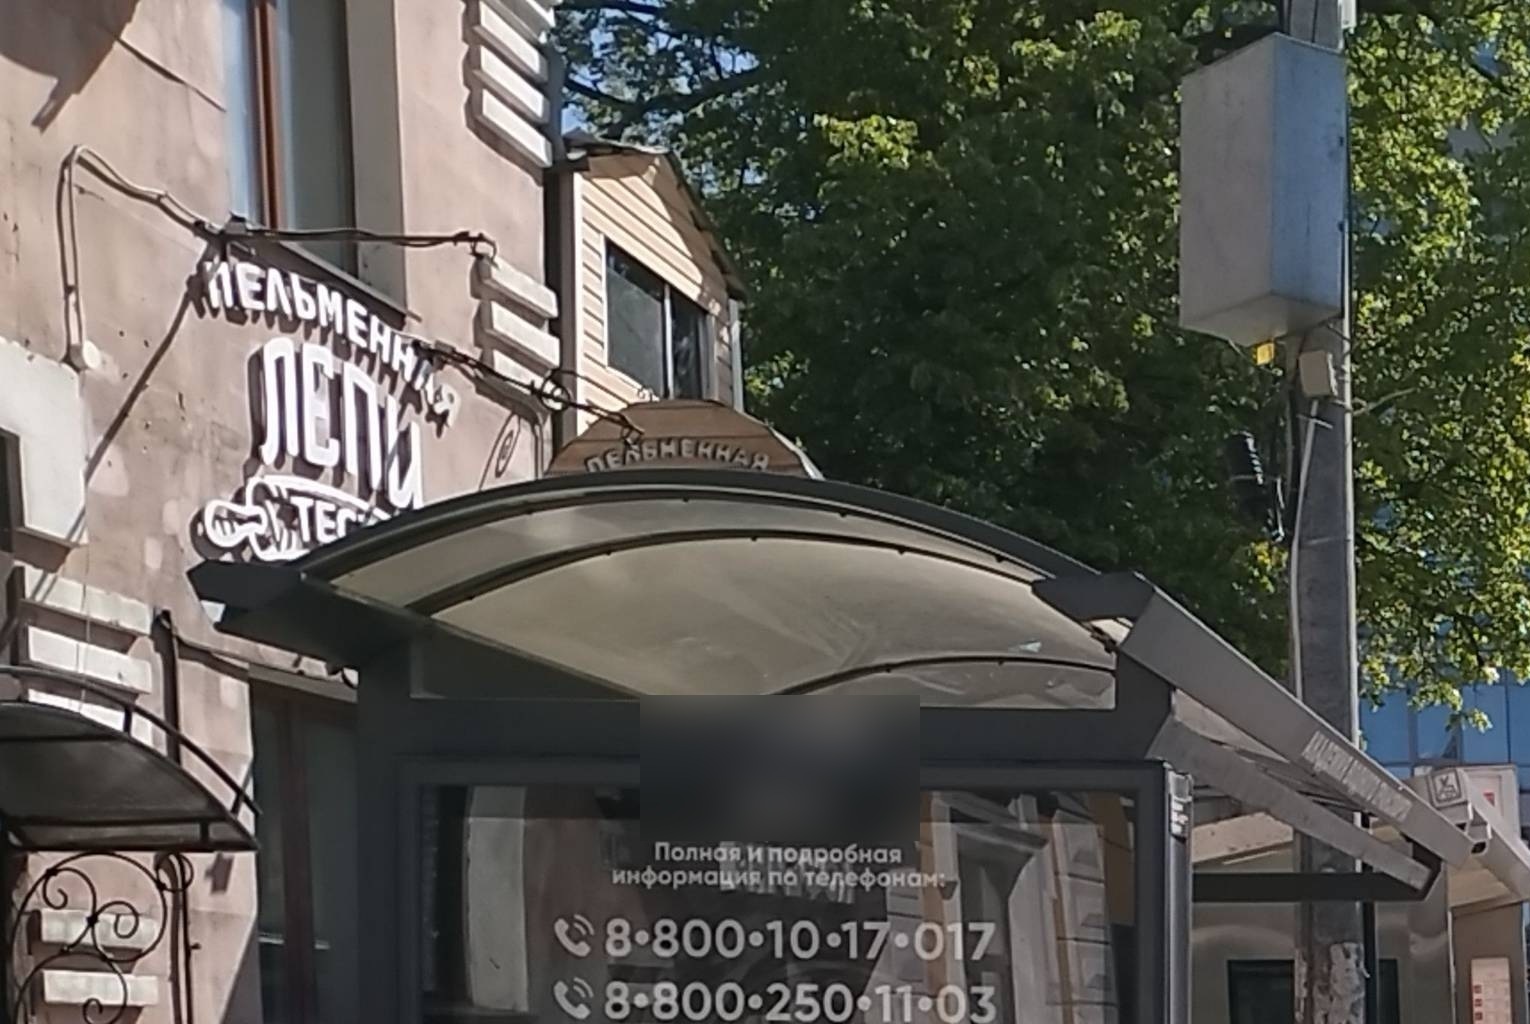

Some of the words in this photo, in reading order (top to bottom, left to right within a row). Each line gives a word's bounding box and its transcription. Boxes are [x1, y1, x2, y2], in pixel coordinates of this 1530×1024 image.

[204, 257, 460, 428] ПЕЛЬМЕННАЯ
[262, 337, 424, 510] ЛЕПИ
[585, 437, 769, 473] ПЕЛЬМЕННАЯ
[655, 842, 740, 862] Полная
[748, 846, 763, 861] и
[768, 844, 902, 866] подробная
[612, 865, 763, 890] информация
[768, 869, 798, 886] по
[805, 868, 946, 892] телефонам:
